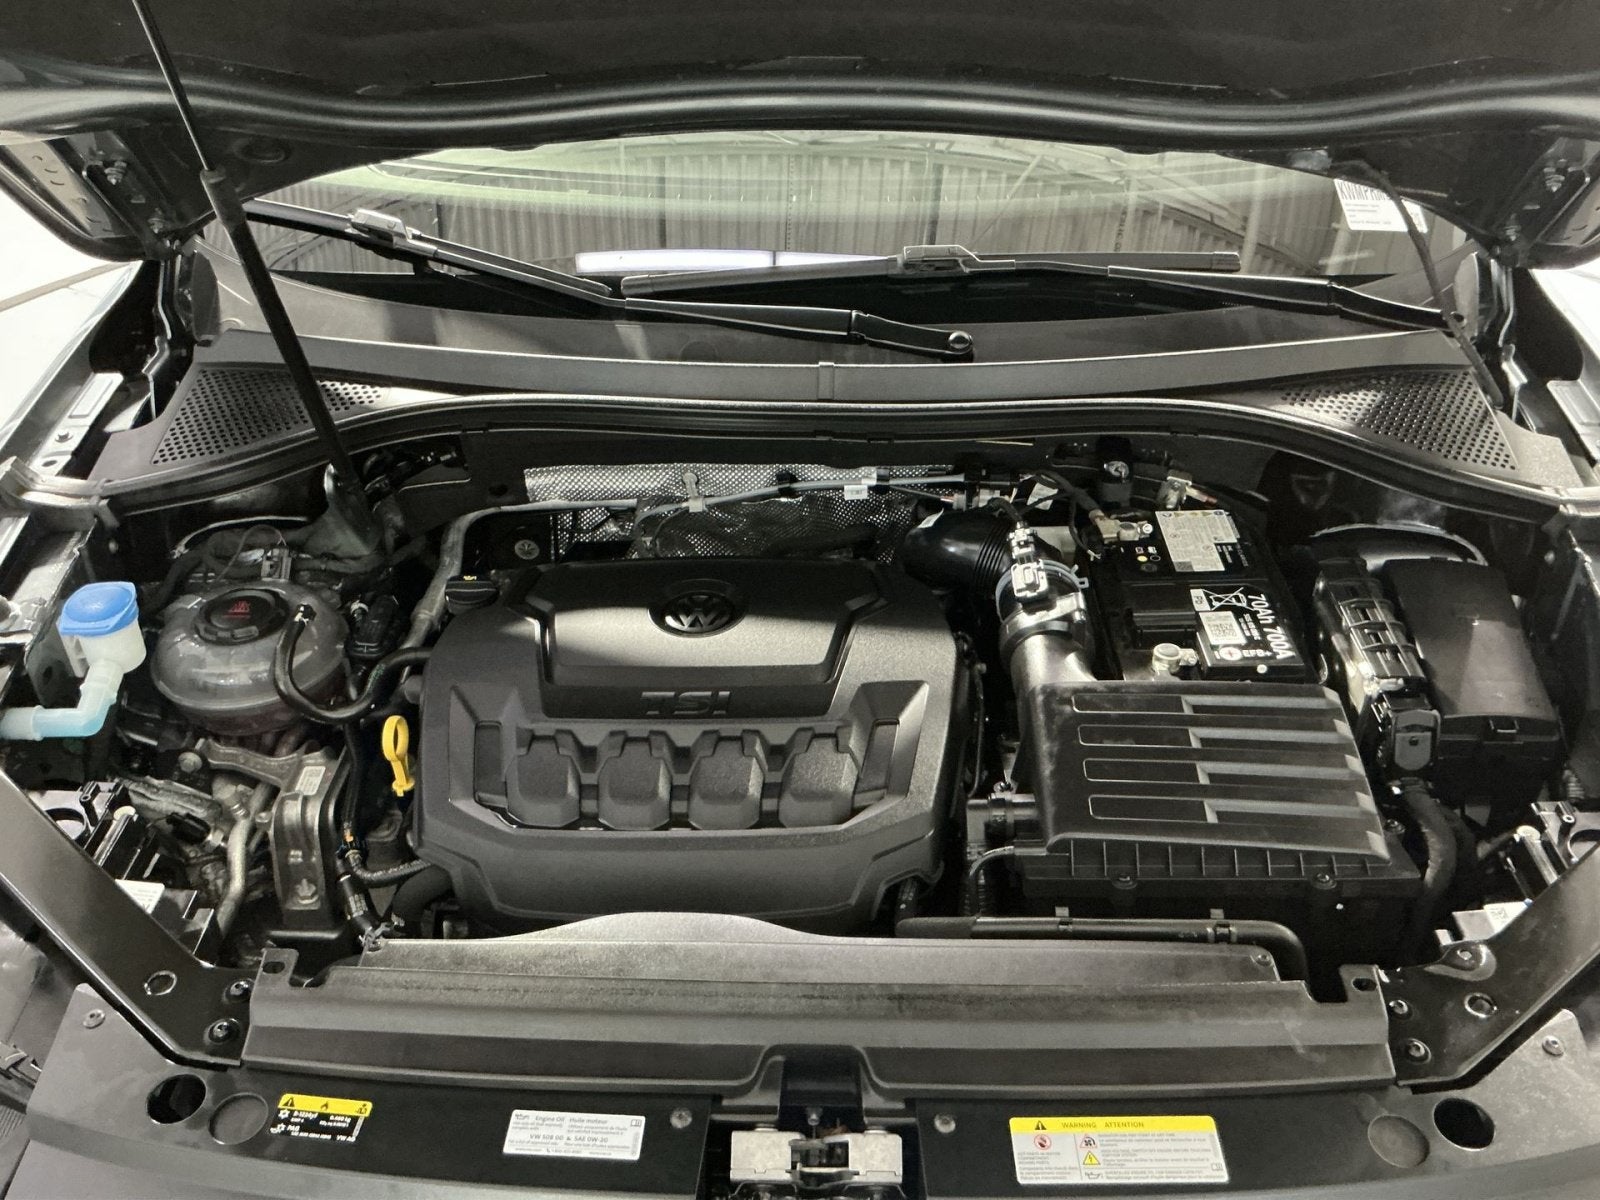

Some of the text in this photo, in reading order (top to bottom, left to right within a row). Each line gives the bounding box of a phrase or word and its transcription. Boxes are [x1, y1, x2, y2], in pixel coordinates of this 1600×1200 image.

[1248, 593, 1275, 624] 70Ah
[1263, 626, 1296, 659] 700A
[641, 691, 730, 715] TSI
[535, 1115, 555, 1123] Engine
